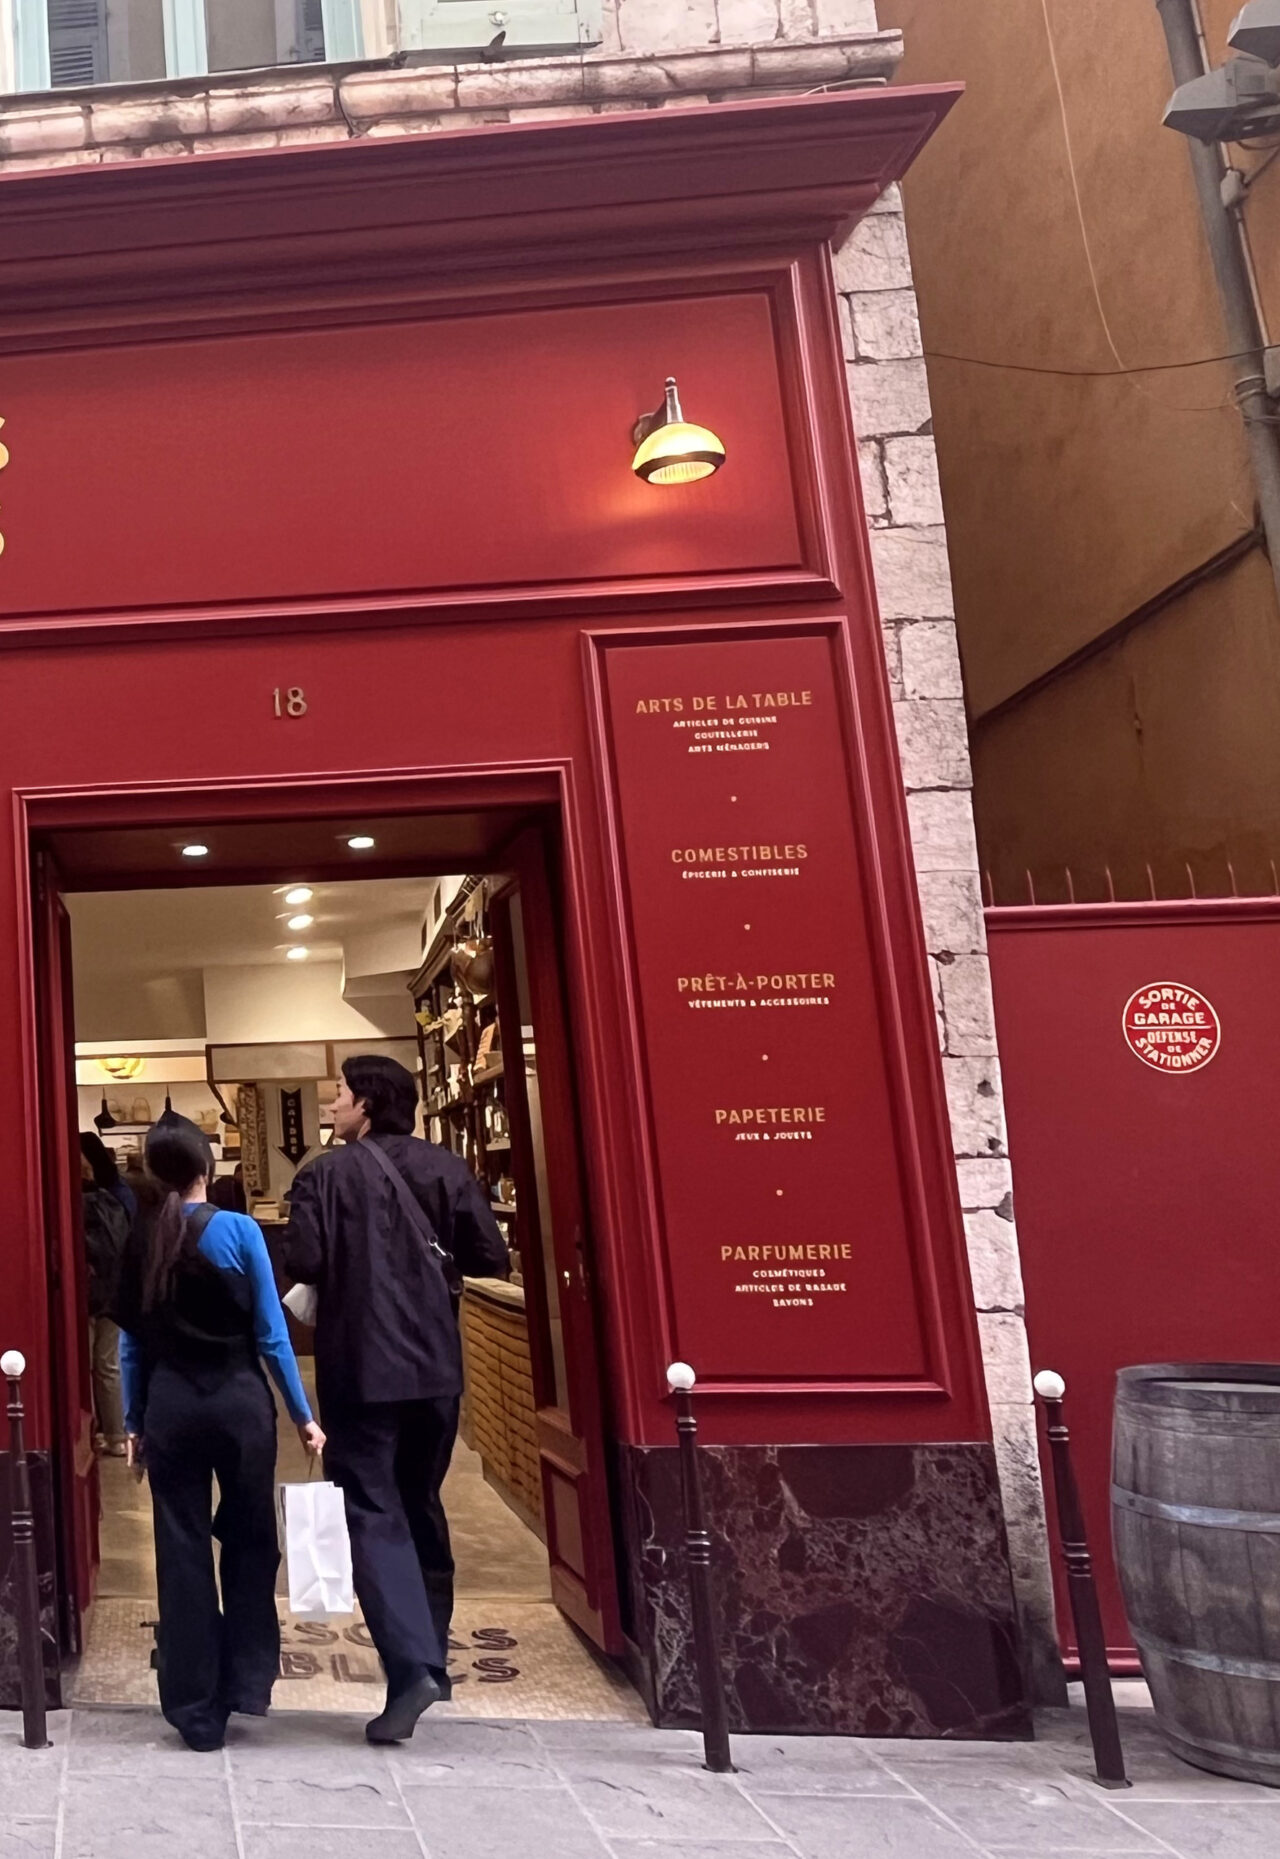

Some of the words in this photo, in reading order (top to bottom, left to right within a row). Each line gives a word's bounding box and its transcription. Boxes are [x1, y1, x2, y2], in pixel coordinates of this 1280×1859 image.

[273, 686, 307, 717] 18
[636, 698, 684, 713] ARTS
[693, 696, 717, 711] DE
[726, 694, 748, 709] LA
[752, 691, 812, 708] TABLE
[671, 844, 808, 863] COMESTIBLES
[678, 973, 835, 992] PRÊT-À-PORTER
[1139, 988, 1199, 1010] SORTIE
[1134, 1012, 1206, 1024] GARAGE
[1135, 1037, 1212, 1067] STATIONNER
[715, 1107, 826, 1124] PAPETERIE
[721, 1244, 852, 1261] PARFUMERIE
